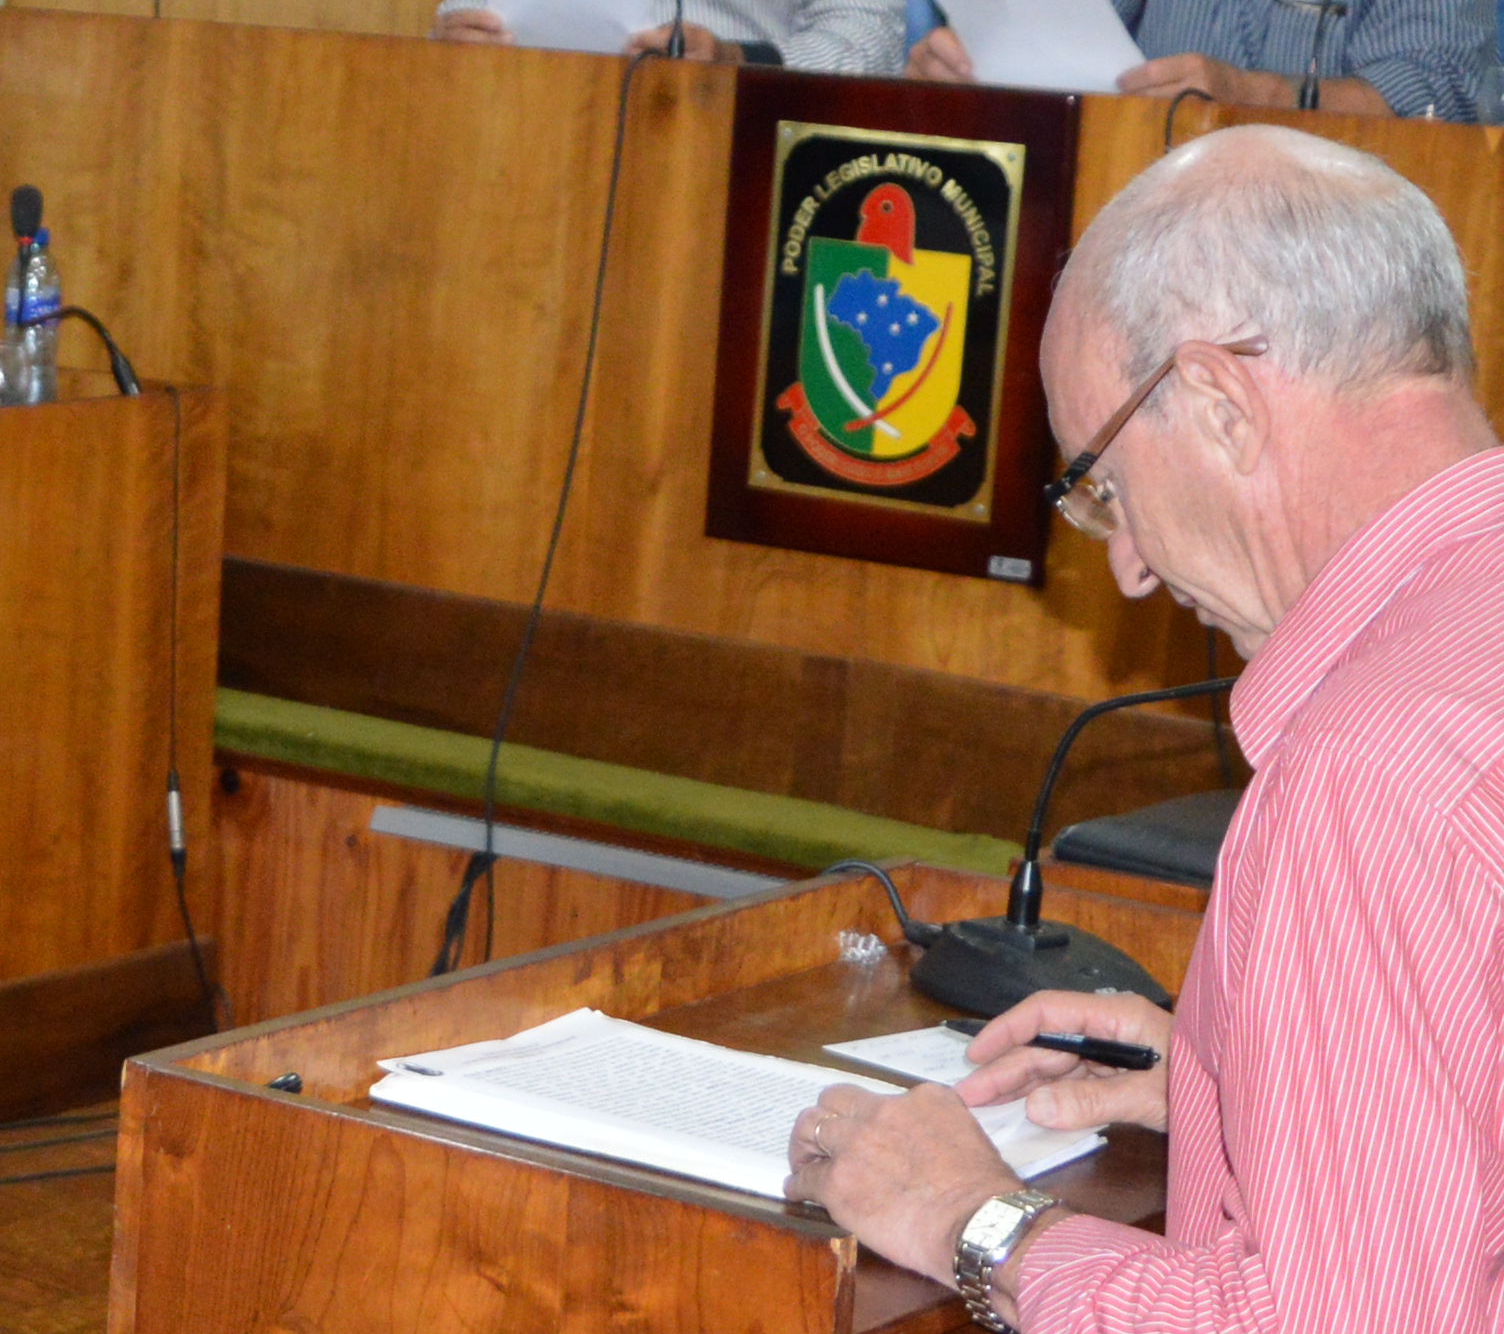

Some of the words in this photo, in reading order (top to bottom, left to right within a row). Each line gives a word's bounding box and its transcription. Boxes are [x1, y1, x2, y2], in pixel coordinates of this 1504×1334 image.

[781, 196, 820, 276] PODER
[813, 152, 943, 202] LEGISLATIVO
[941, 178, 996, 297] MUNICIPAL
